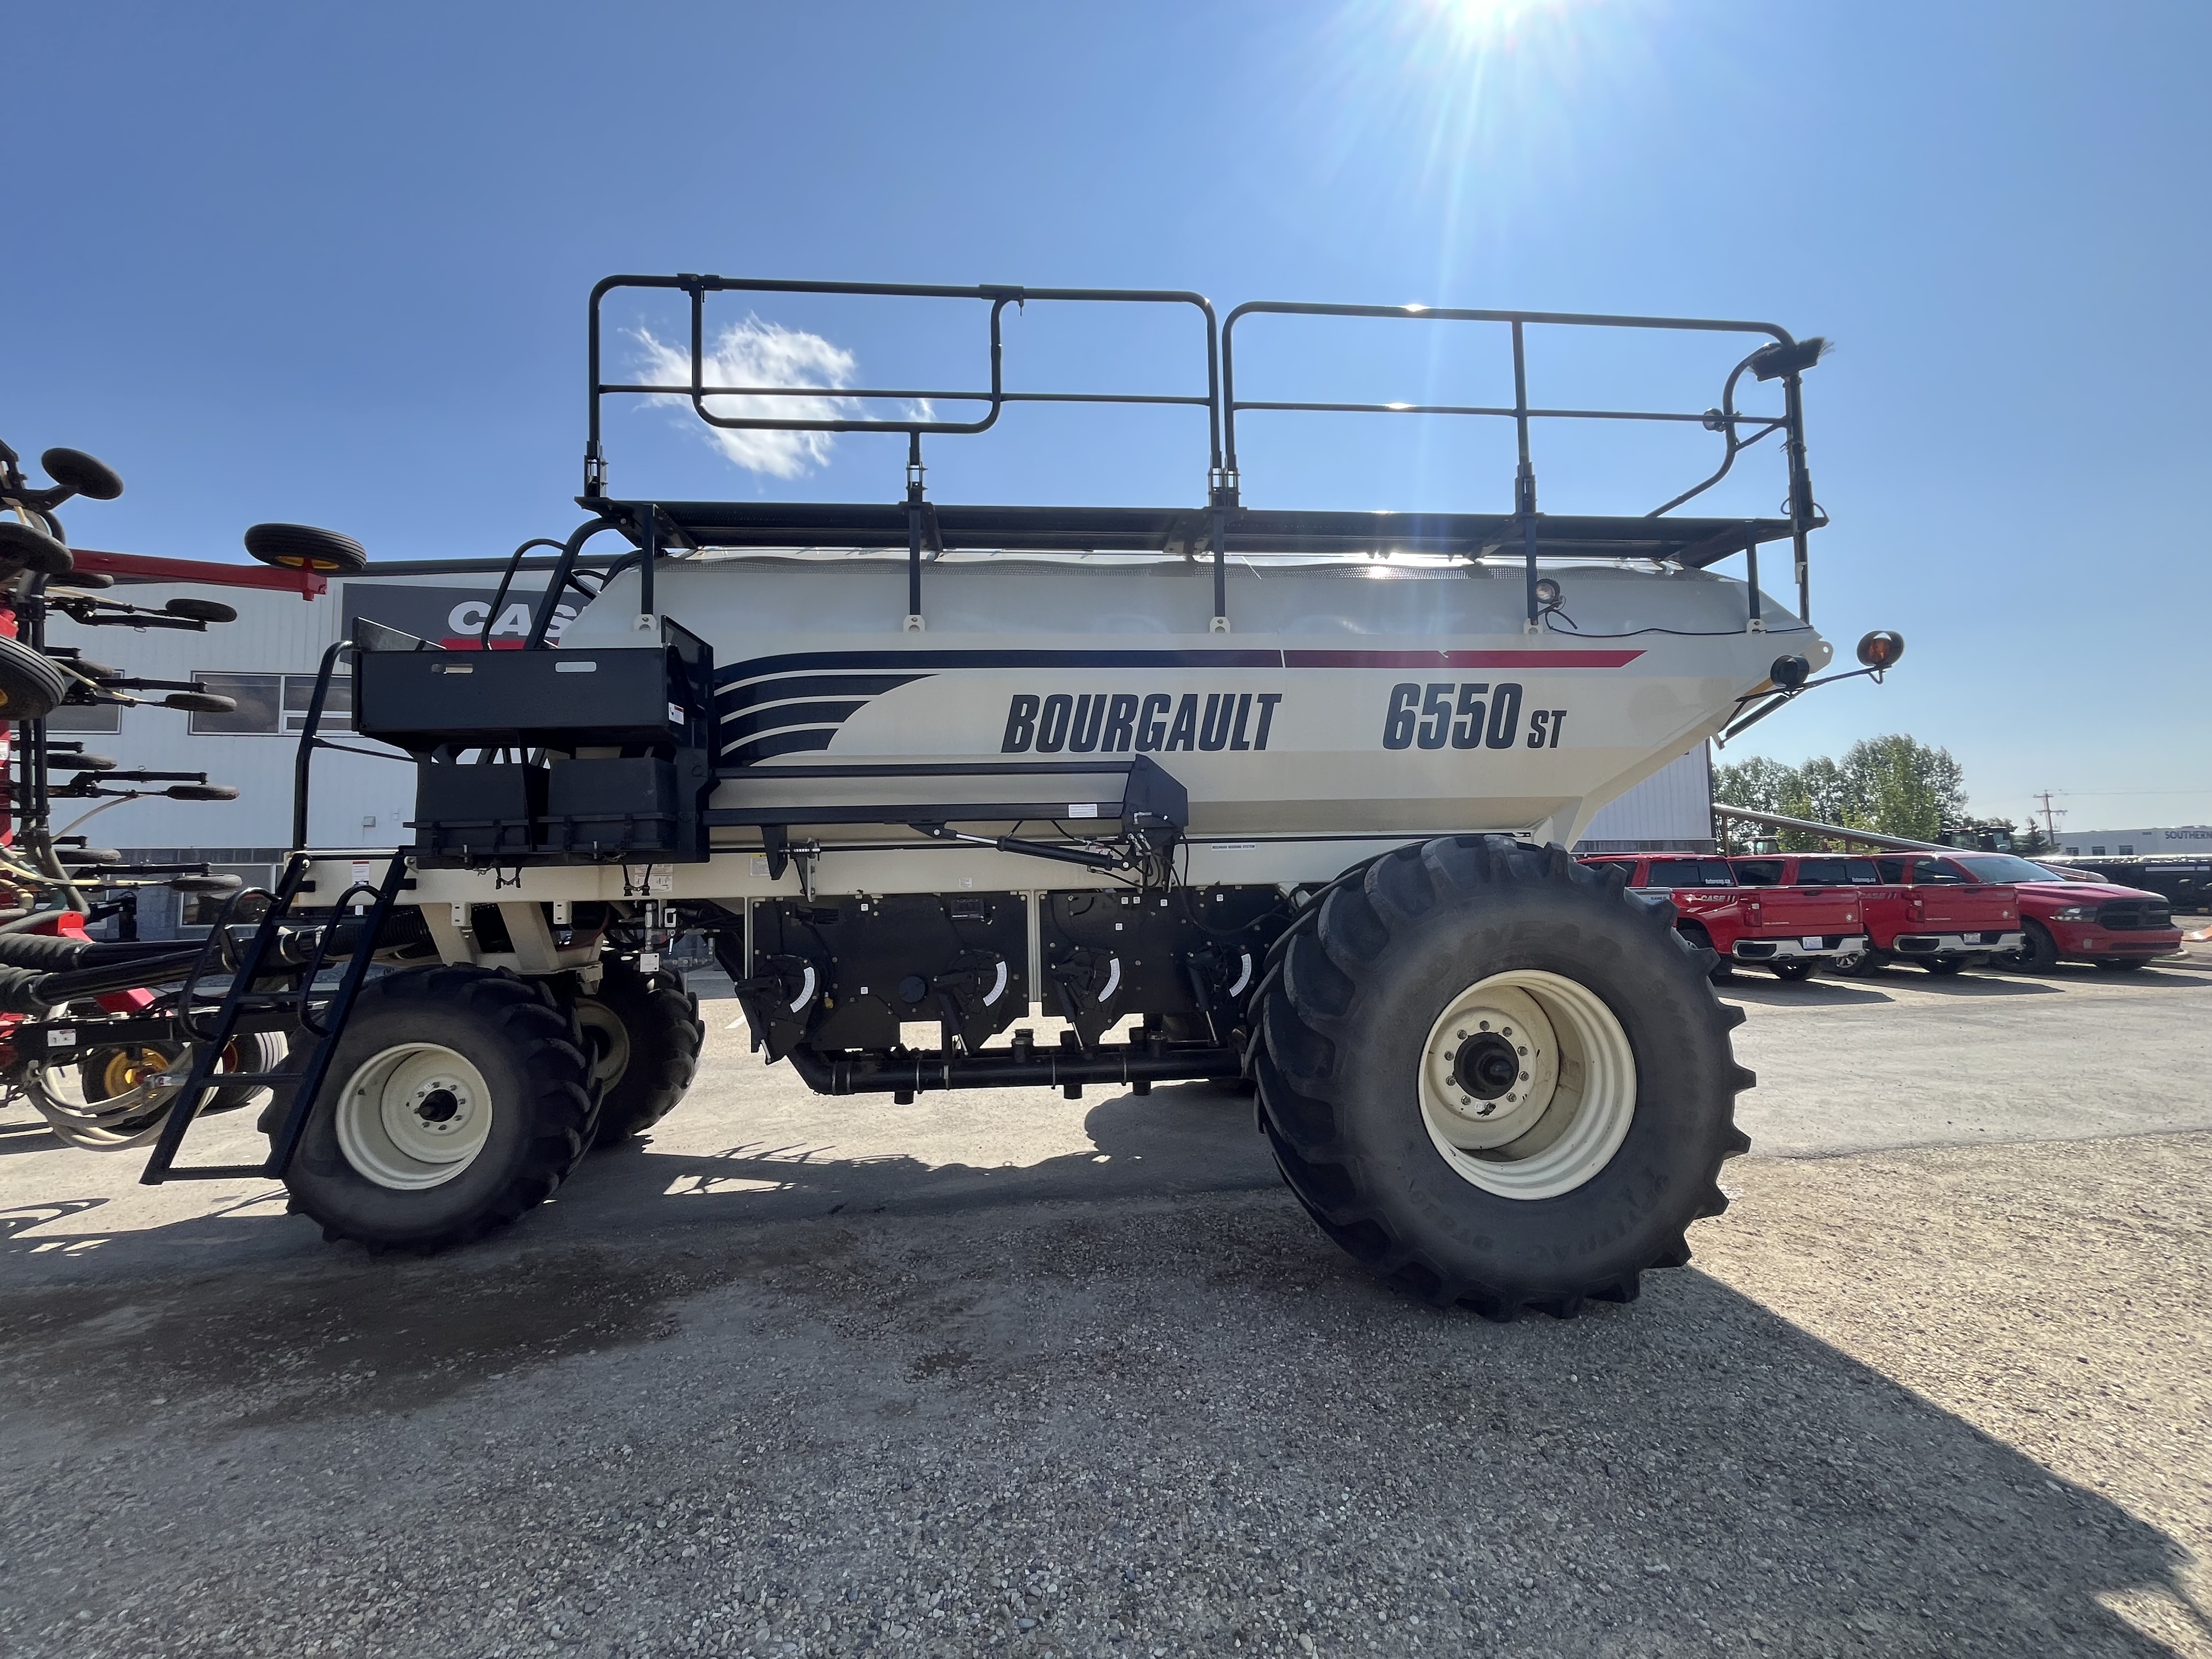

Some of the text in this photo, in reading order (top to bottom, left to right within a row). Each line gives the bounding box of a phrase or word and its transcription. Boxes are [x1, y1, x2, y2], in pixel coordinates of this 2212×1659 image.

[448, 600, 588, 638] CAS
[1000, 693, 1283, 753] BOURGAULT
[1383, 683, 1567, 750] 6550 ST
